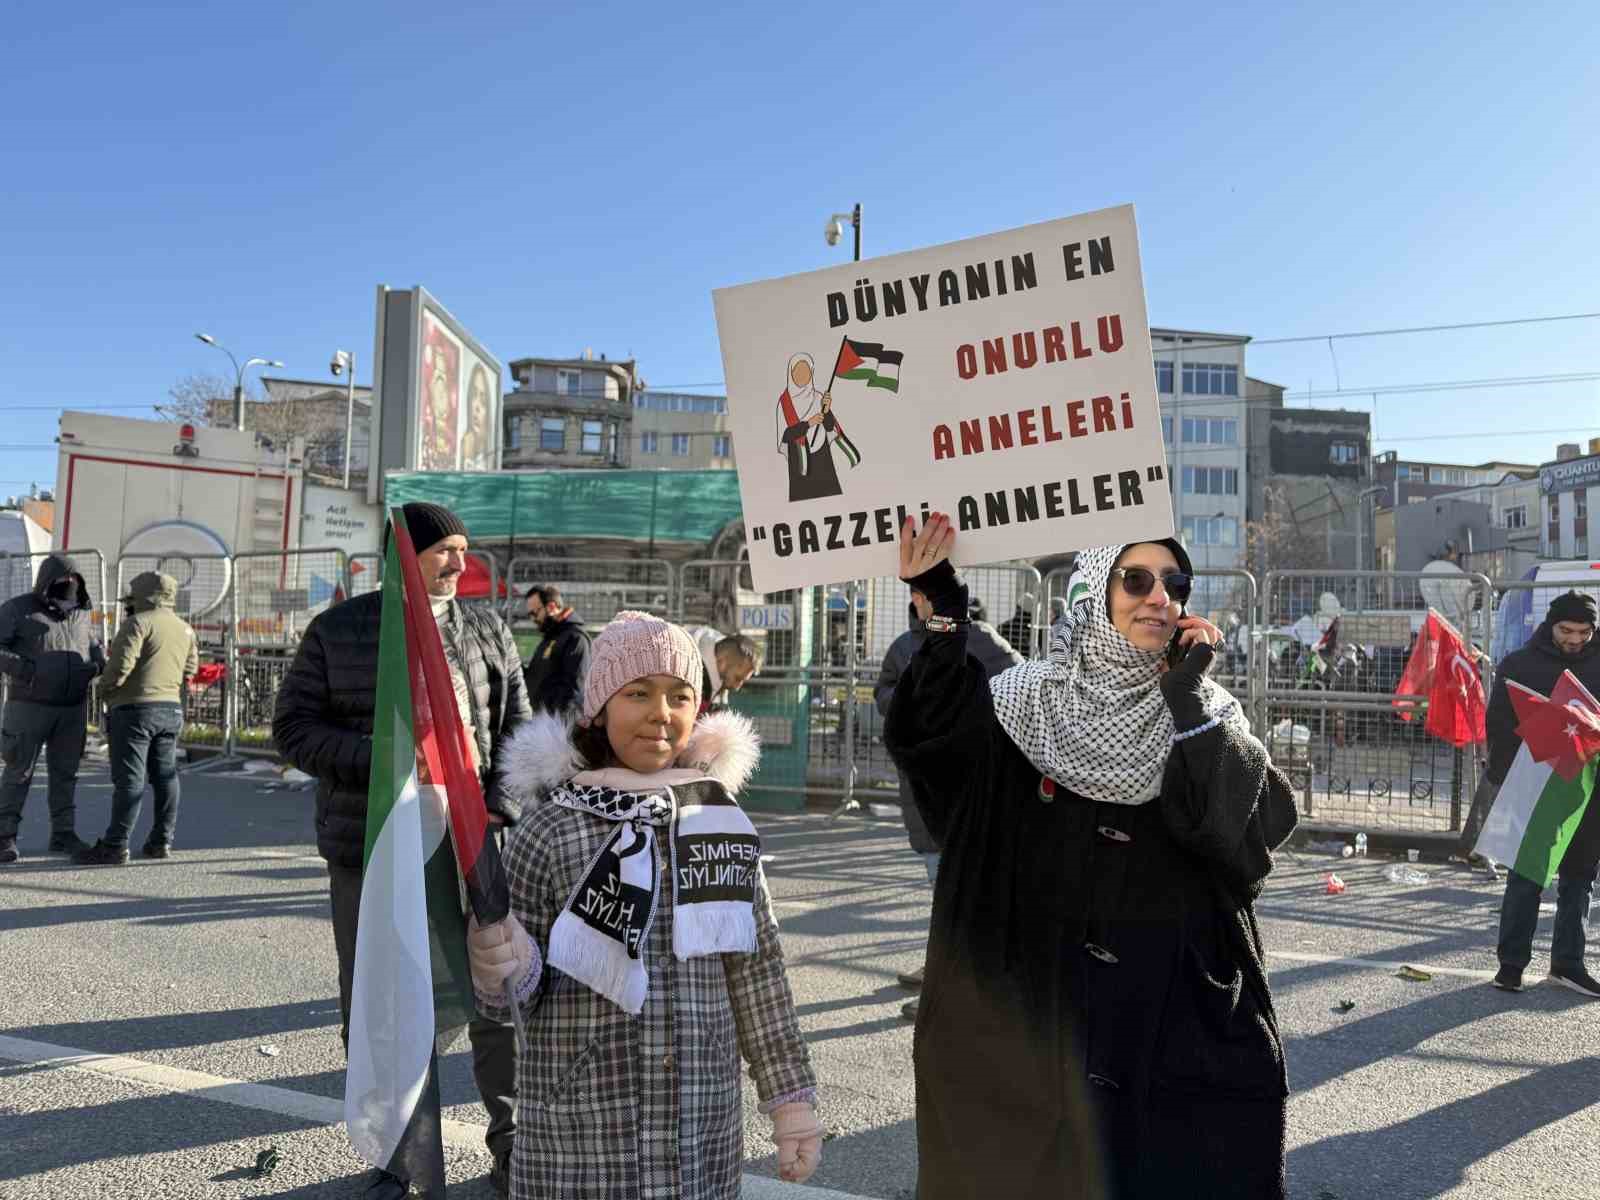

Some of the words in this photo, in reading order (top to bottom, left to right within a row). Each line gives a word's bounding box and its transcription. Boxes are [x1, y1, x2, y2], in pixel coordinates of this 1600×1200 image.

[826, 252, 1038, 328] DÜNYANIN
[1062, 236, 1115, 281] EN
[956, 314, 1124, 380] ONURLU
[958, 465, 1164, 532] ANNELER"
